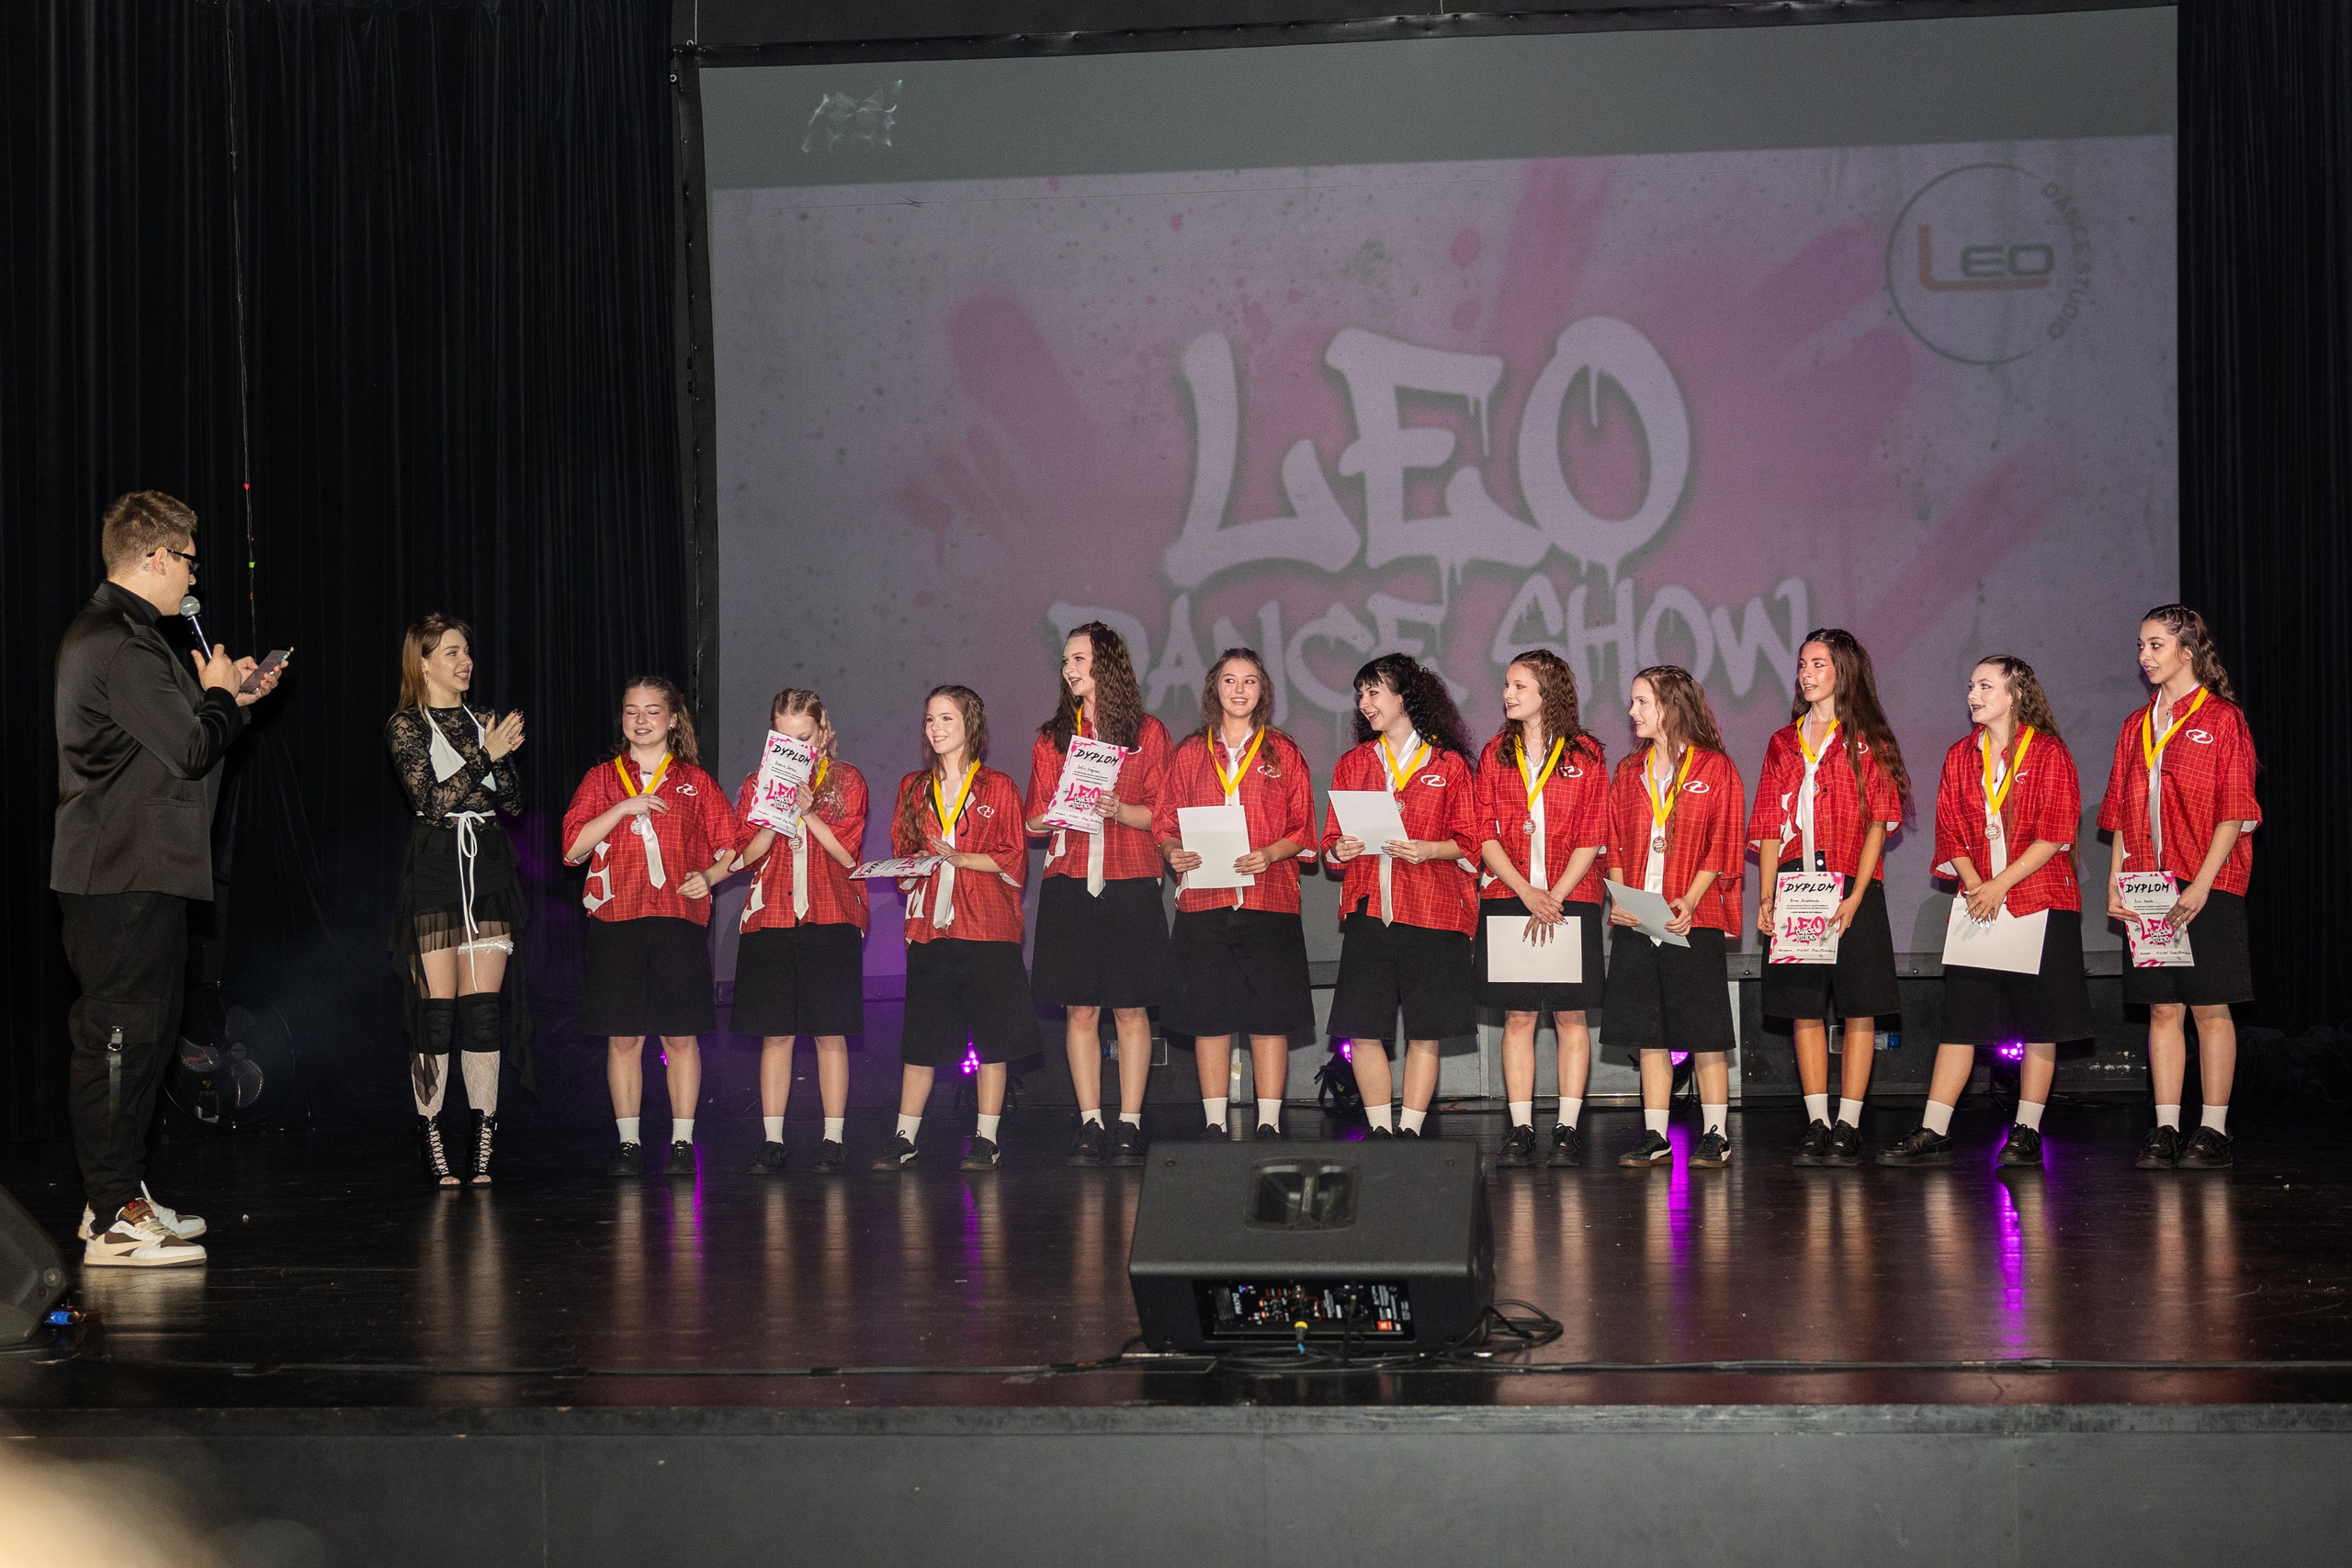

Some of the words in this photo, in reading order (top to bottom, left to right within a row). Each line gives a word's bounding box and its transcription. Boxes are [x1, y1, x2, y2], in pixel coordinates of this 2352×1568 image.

[2041, 182, 2092, 254] DANCE
[1917, 223, 2055, 292] LEO
[2047, 261, 2093, 340] STUDIO
[1163, 315, 1691, 589] LEO
[1046, 592, 1468, 726] DANCE
[1491, 573, 1810, 709] SHOW
[772, 744, 811, 766] DYPLOM
[1074, 749, 1119, 766] DYPLOM
[1783, 883, 1836, 893] DYPLOM
[2125, 883, 2169, 893] DYPLOM
[1785, 916, 1826, 938] LEO
